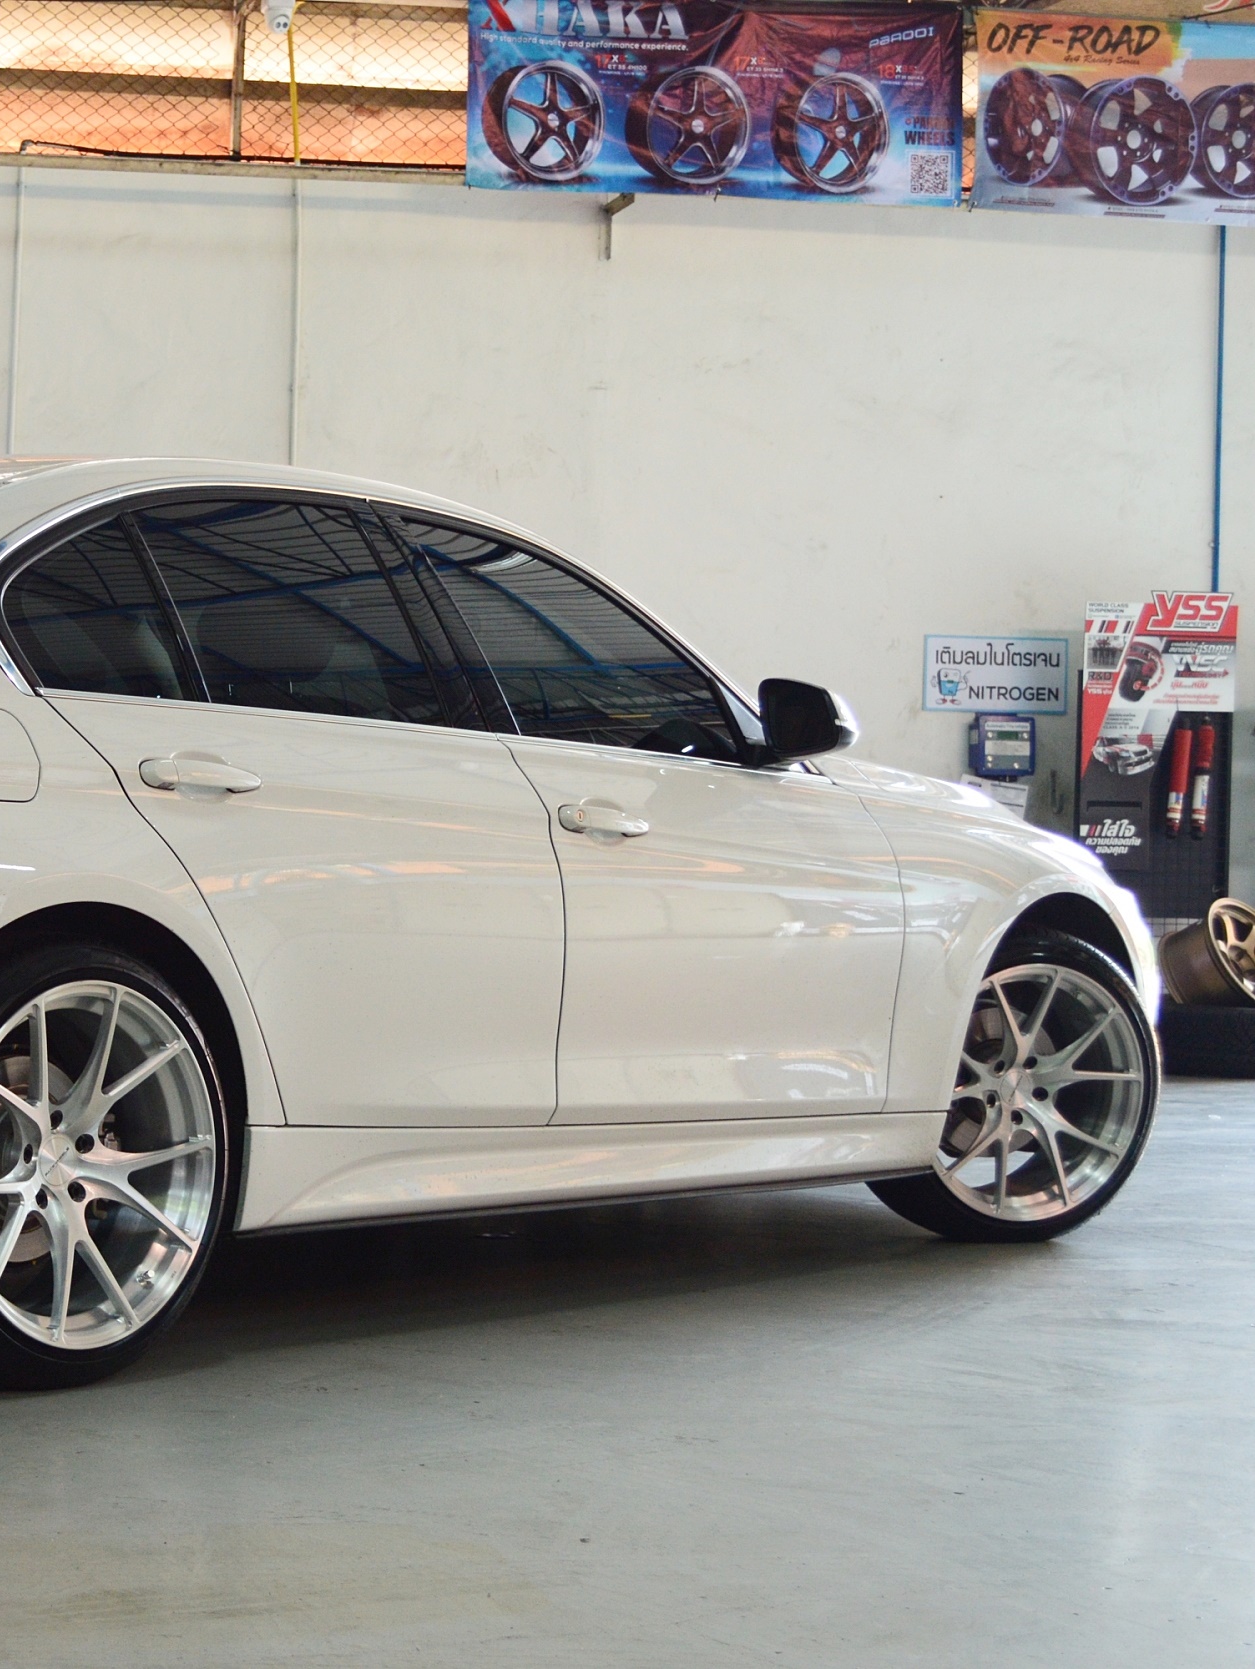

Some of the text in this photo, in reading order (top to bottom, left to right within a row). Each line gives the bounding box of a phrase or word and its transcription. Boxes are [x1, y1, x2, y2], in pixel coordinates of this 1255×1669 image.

[499, 34, 538, 44] standard
[585, 41, 640, 50] performance
[640, 42, 689, 51] experience.
[904, 130, 955, 146] WHEELS
[1149, 593, 1229, 628] YSS
[935, 642, 1060, 668] เติมลมไนโตรเจน
[968, 686, 1059, 701] NITROGEN
